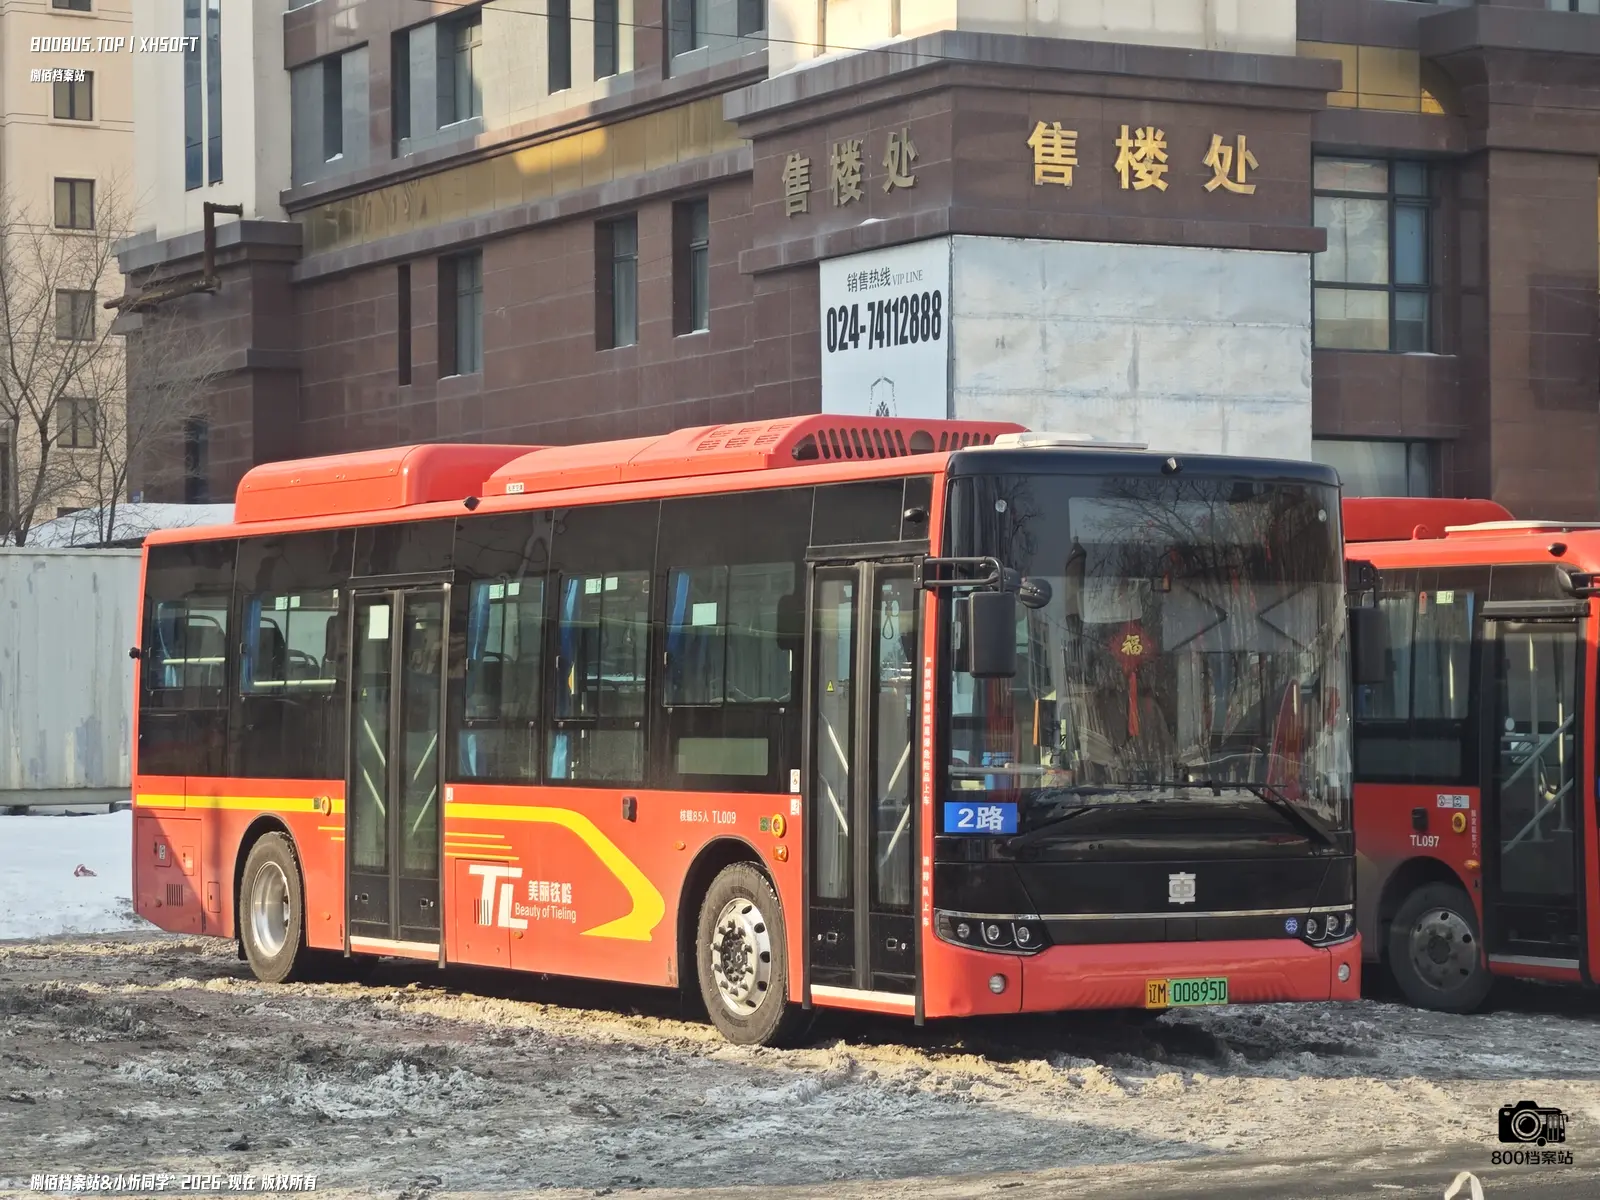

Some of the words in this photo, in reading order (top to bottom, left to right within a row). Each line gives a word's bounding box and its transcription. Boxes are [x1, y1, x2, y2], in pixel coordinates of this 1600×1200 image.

[1026, 120, 1260, 195] 售楼处
[782, 127, 919, 217] 售楼处
[847, 266, 891, 292] 销售热线
[892, 273, 905, 285] VIP
[906, 269, 923, 283] LINE
[827, 289, 942, 353] 024-74112888
[1121, 634, 1143, 656] 福
[712, 810, 737, 825] TL009
[958, 805, 1004, 831] 2路
[1409, 834, 1440, 848] TL097
[469, 864, 528, 930] TL
[528, 880, 572, 904] 美丽铁岭
[515, 902, 541, 921] Beauty
[542, 905, 550, 918] of
[551, 905, 577, 924] Tieling
